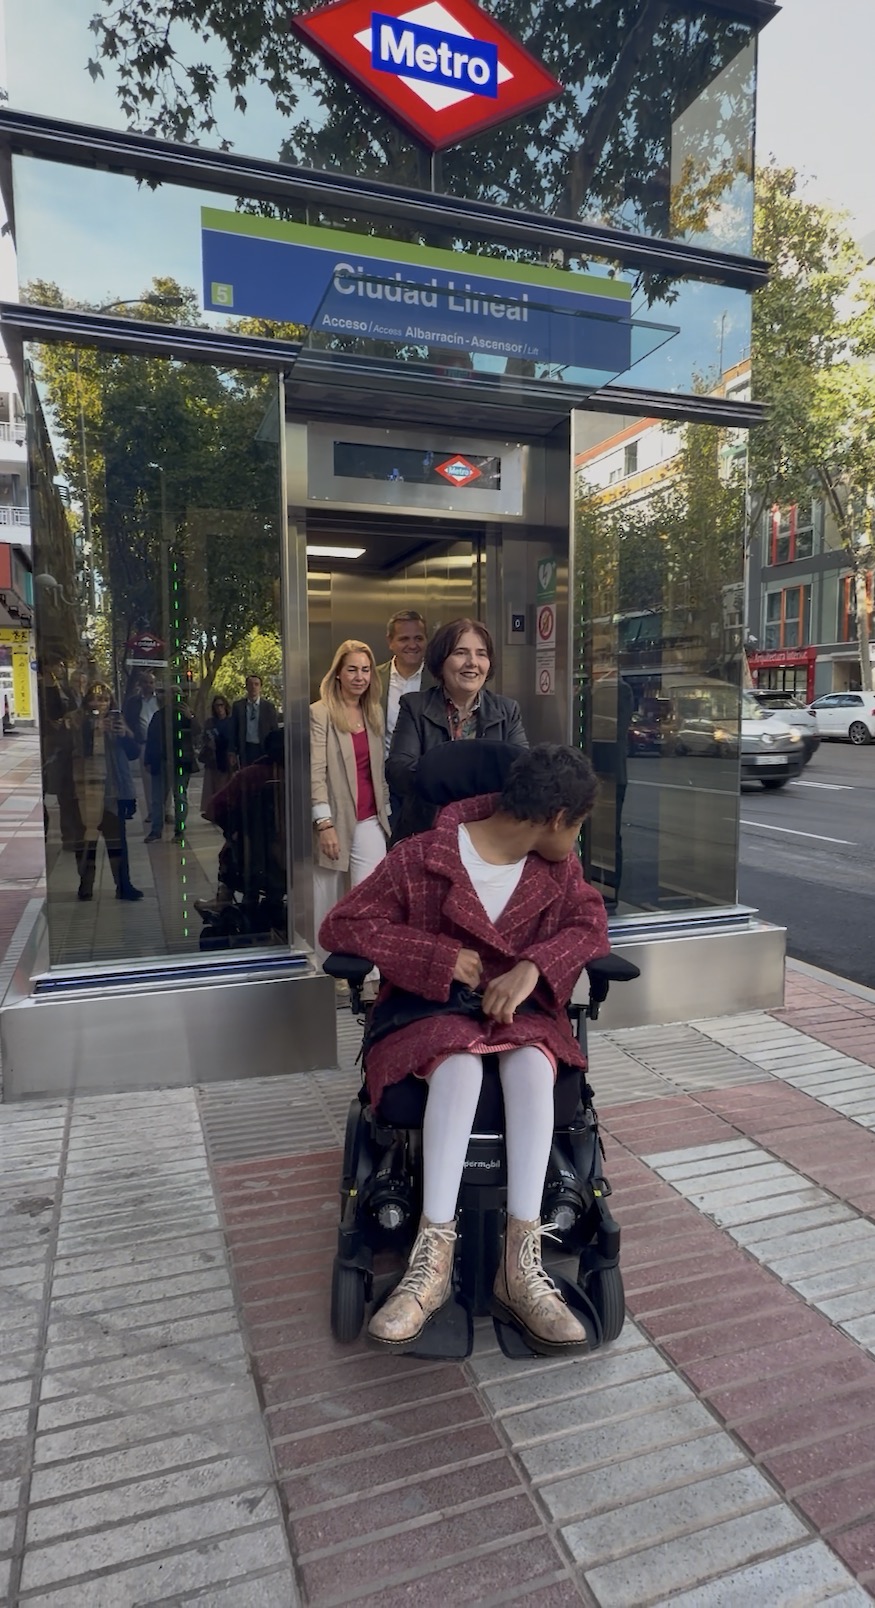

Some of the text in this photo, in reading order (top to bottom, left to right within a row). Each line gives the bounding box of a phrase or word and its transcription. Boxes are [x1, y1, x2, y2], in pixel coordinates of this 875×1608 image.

[380, 23, 491, 86] Metro
[216, 285, 228, 303] 5
[333, 262, 529, 323] Ciudad Lineal
